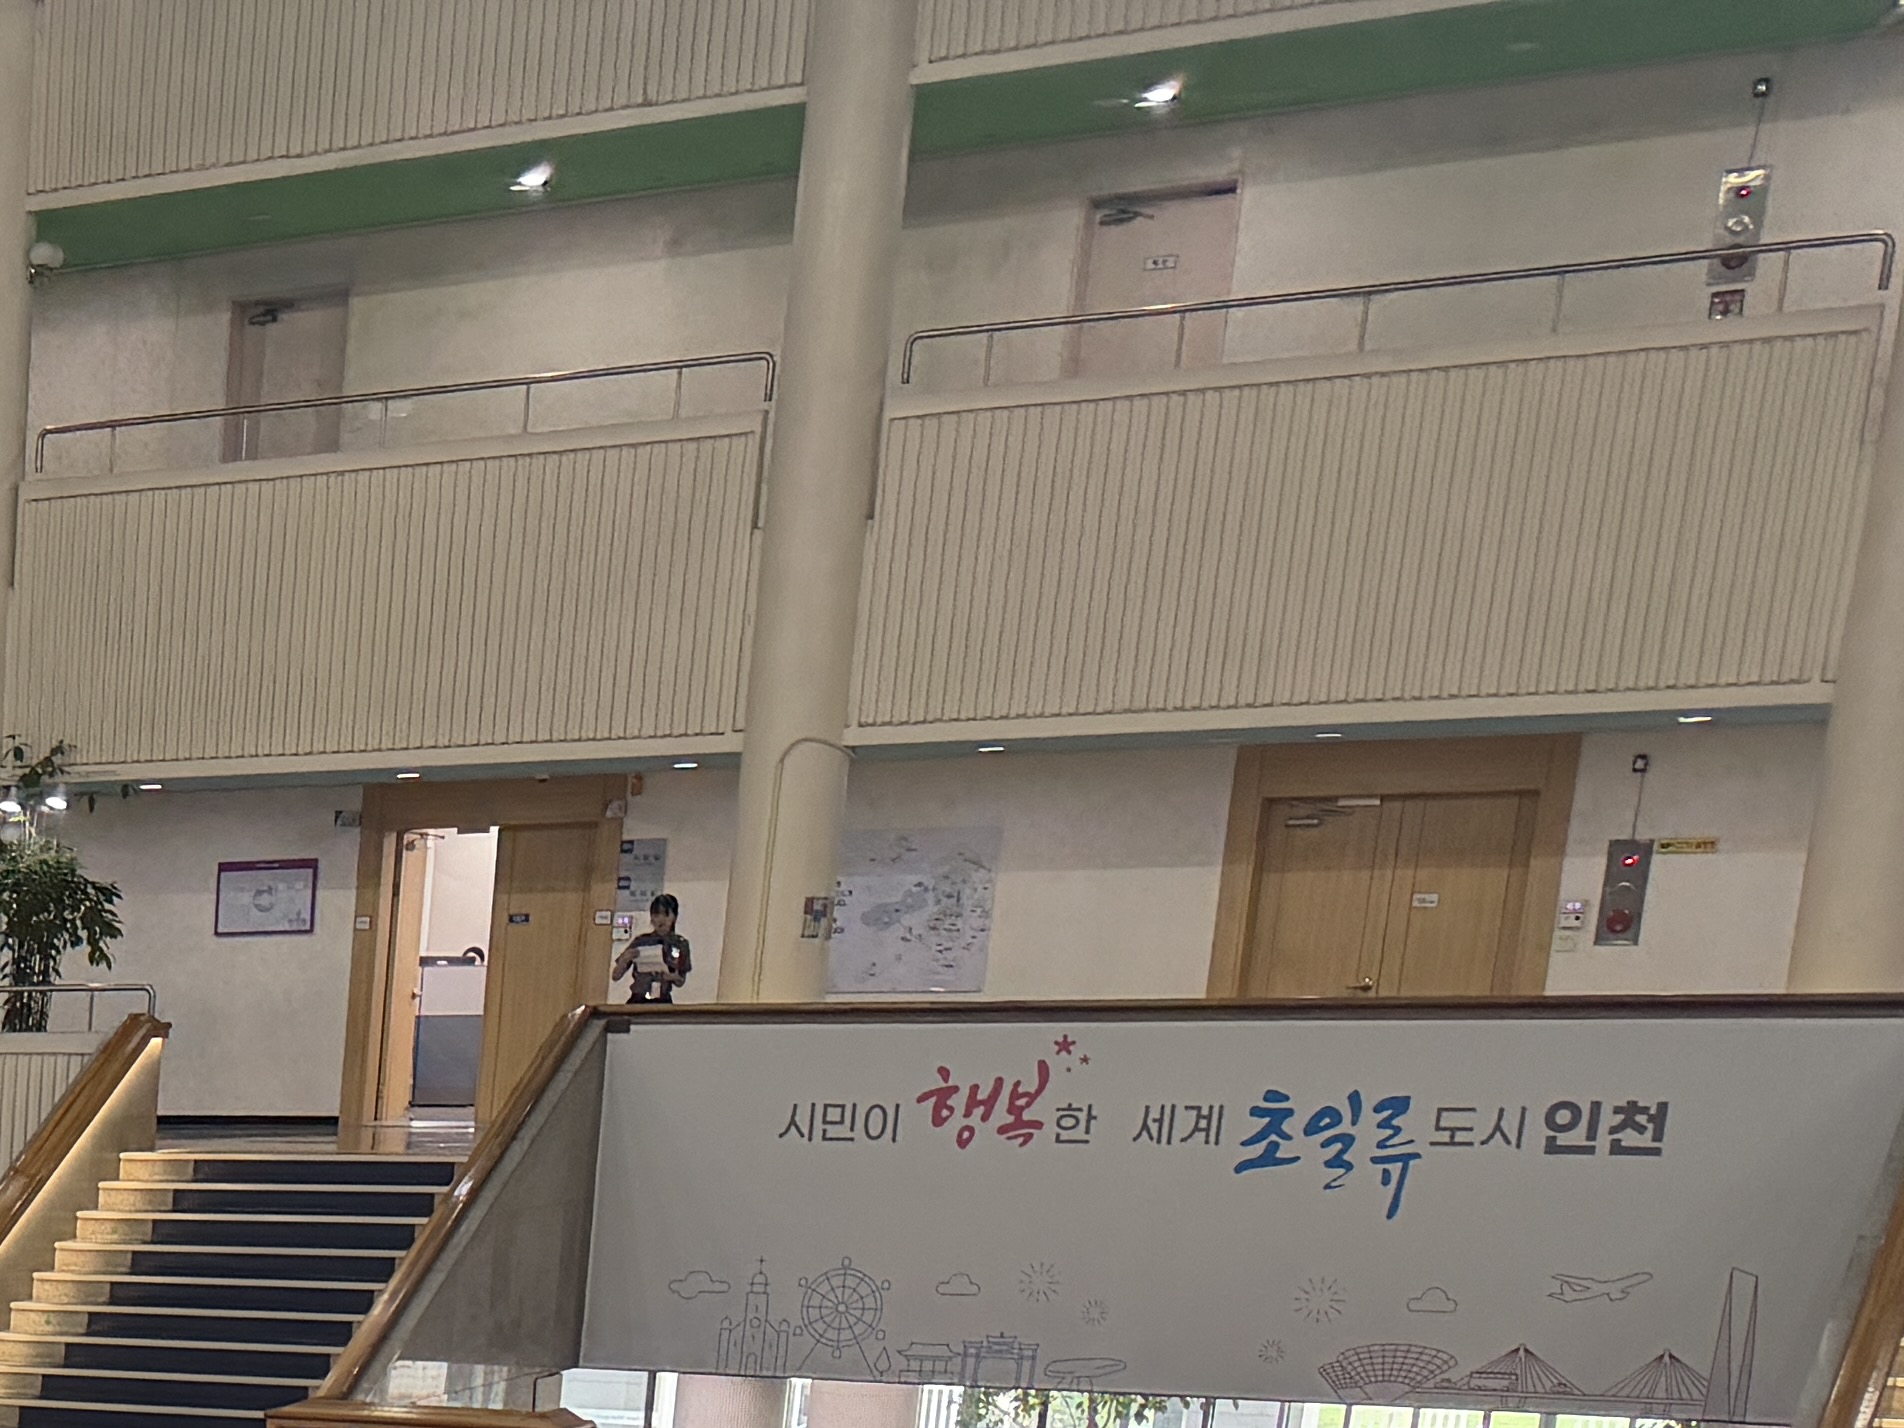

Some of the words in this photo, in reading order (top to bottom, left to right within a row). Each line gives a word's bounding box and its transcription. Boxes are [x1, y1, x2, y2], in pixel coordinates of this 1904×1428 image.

[777, 1101, 902, 1145] 시민이
[915, 1058, 1096, 1152] 행복한
[1132, 1103, 1224, 1149] 세계
[1542, 1098, 1669, 1158] 인천
